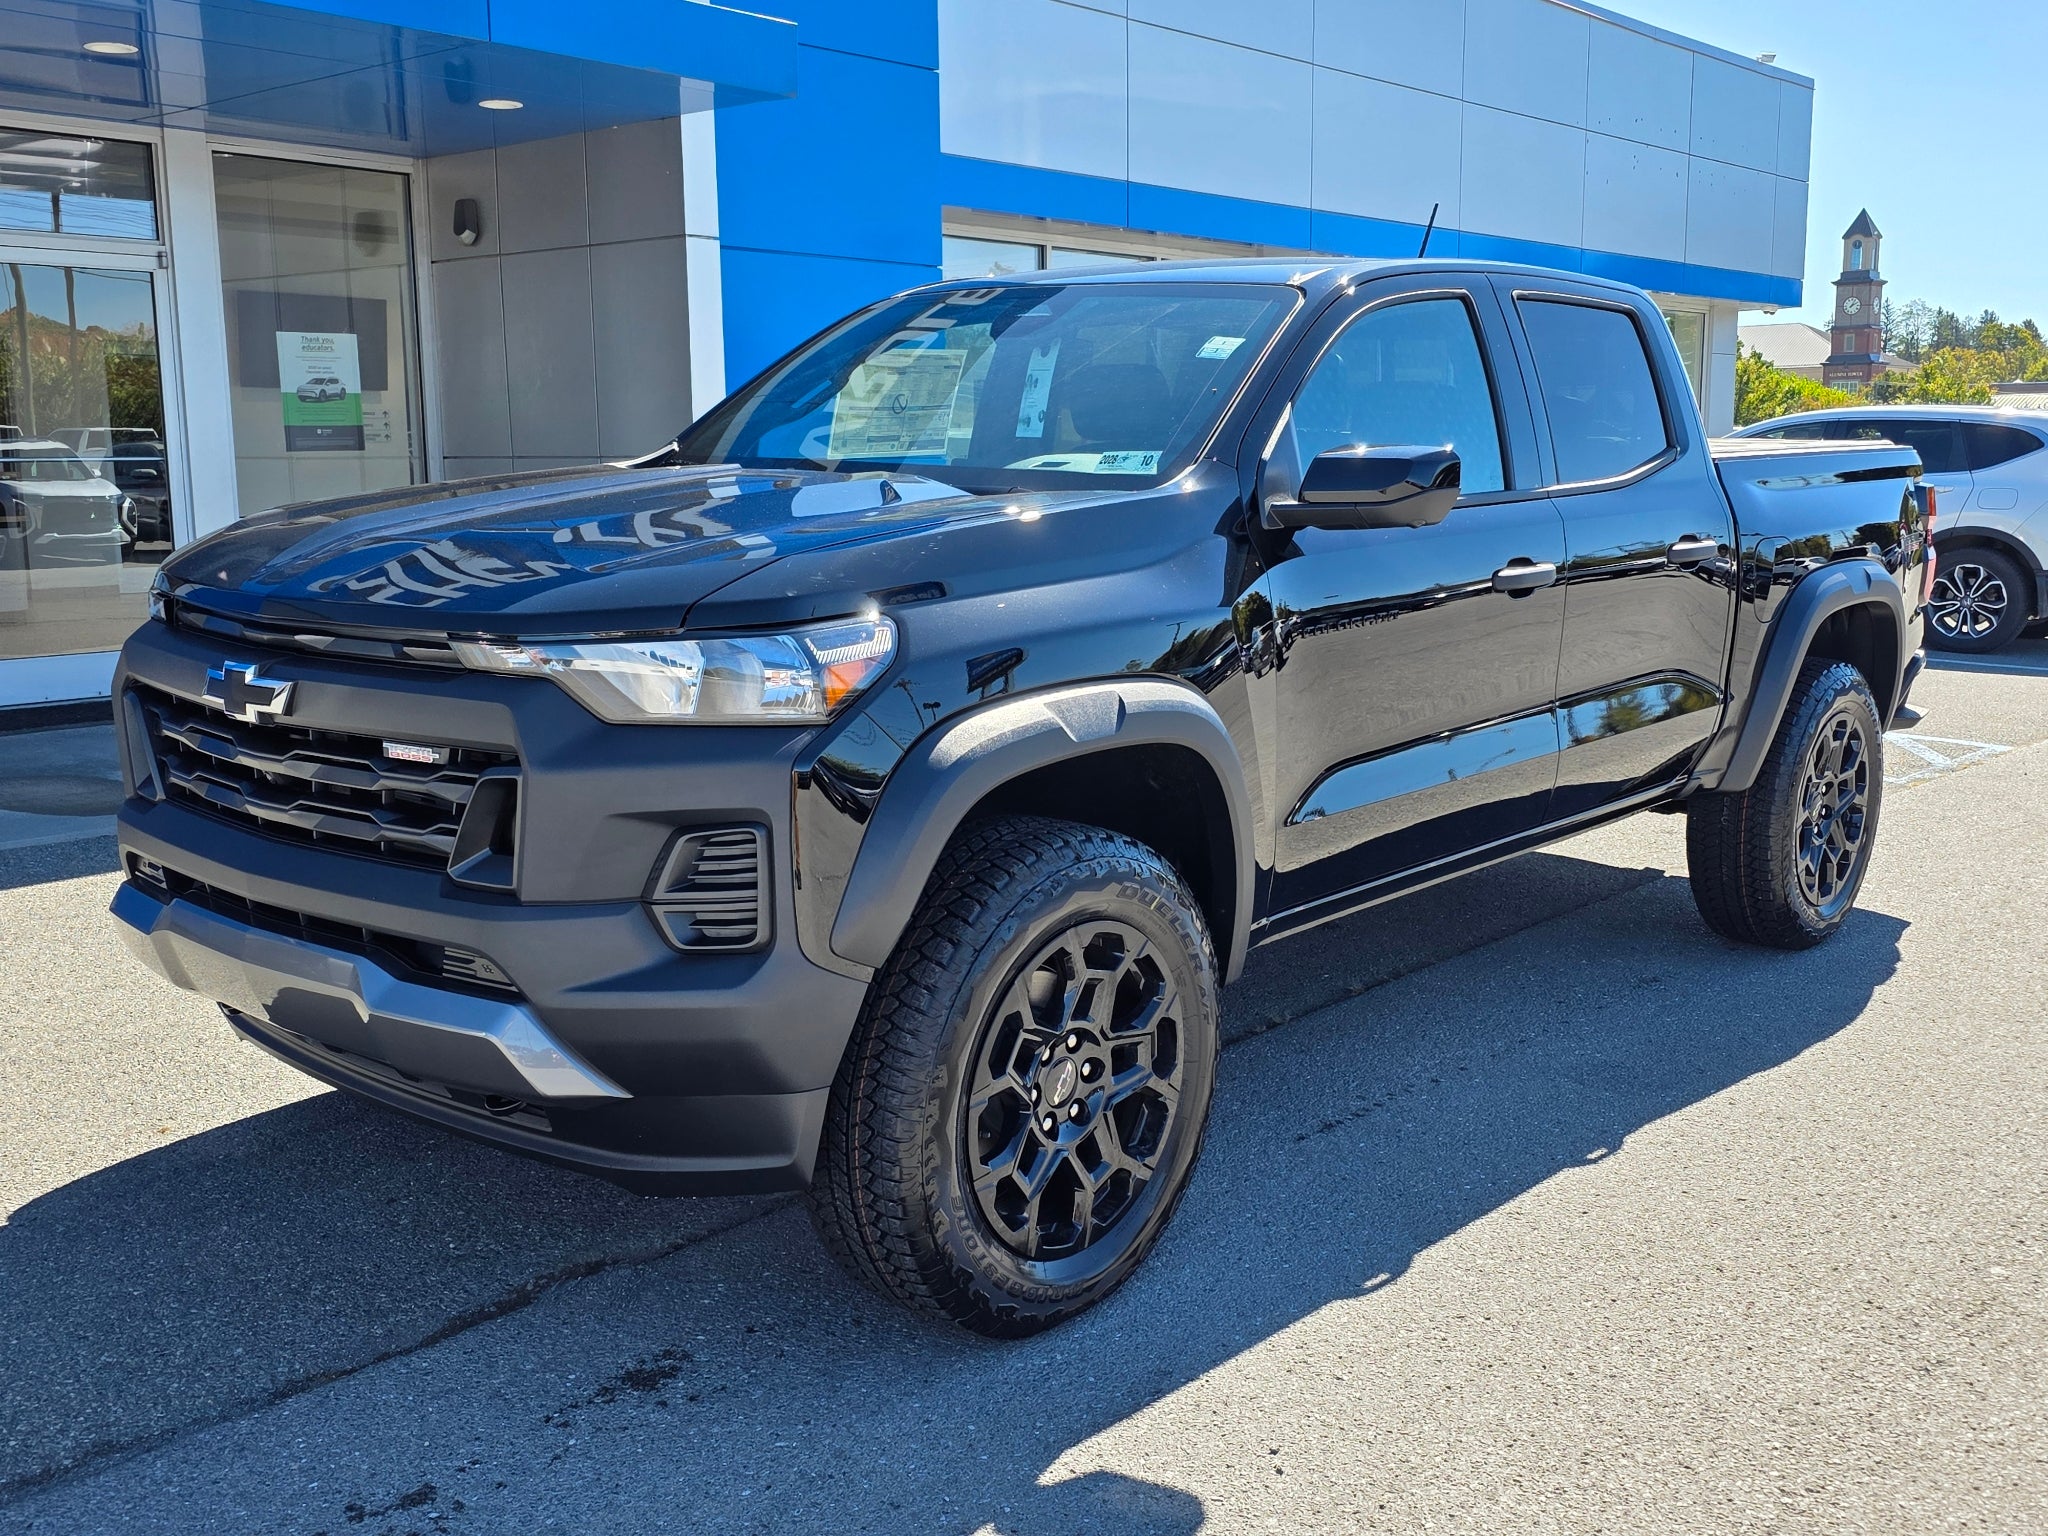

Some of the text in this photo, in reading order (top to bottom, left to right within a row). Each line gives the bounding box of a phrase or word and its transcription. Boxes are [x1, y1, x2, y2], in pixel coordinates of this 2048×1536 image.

[301, 335, 320, 343] Thank
[1140, 454, 1154, 467] 10
[383, 742, 439, 758] TRAIL
[389, 751, 433, 763] BOSS
[1115, 881, 1203, 974] DUELER
